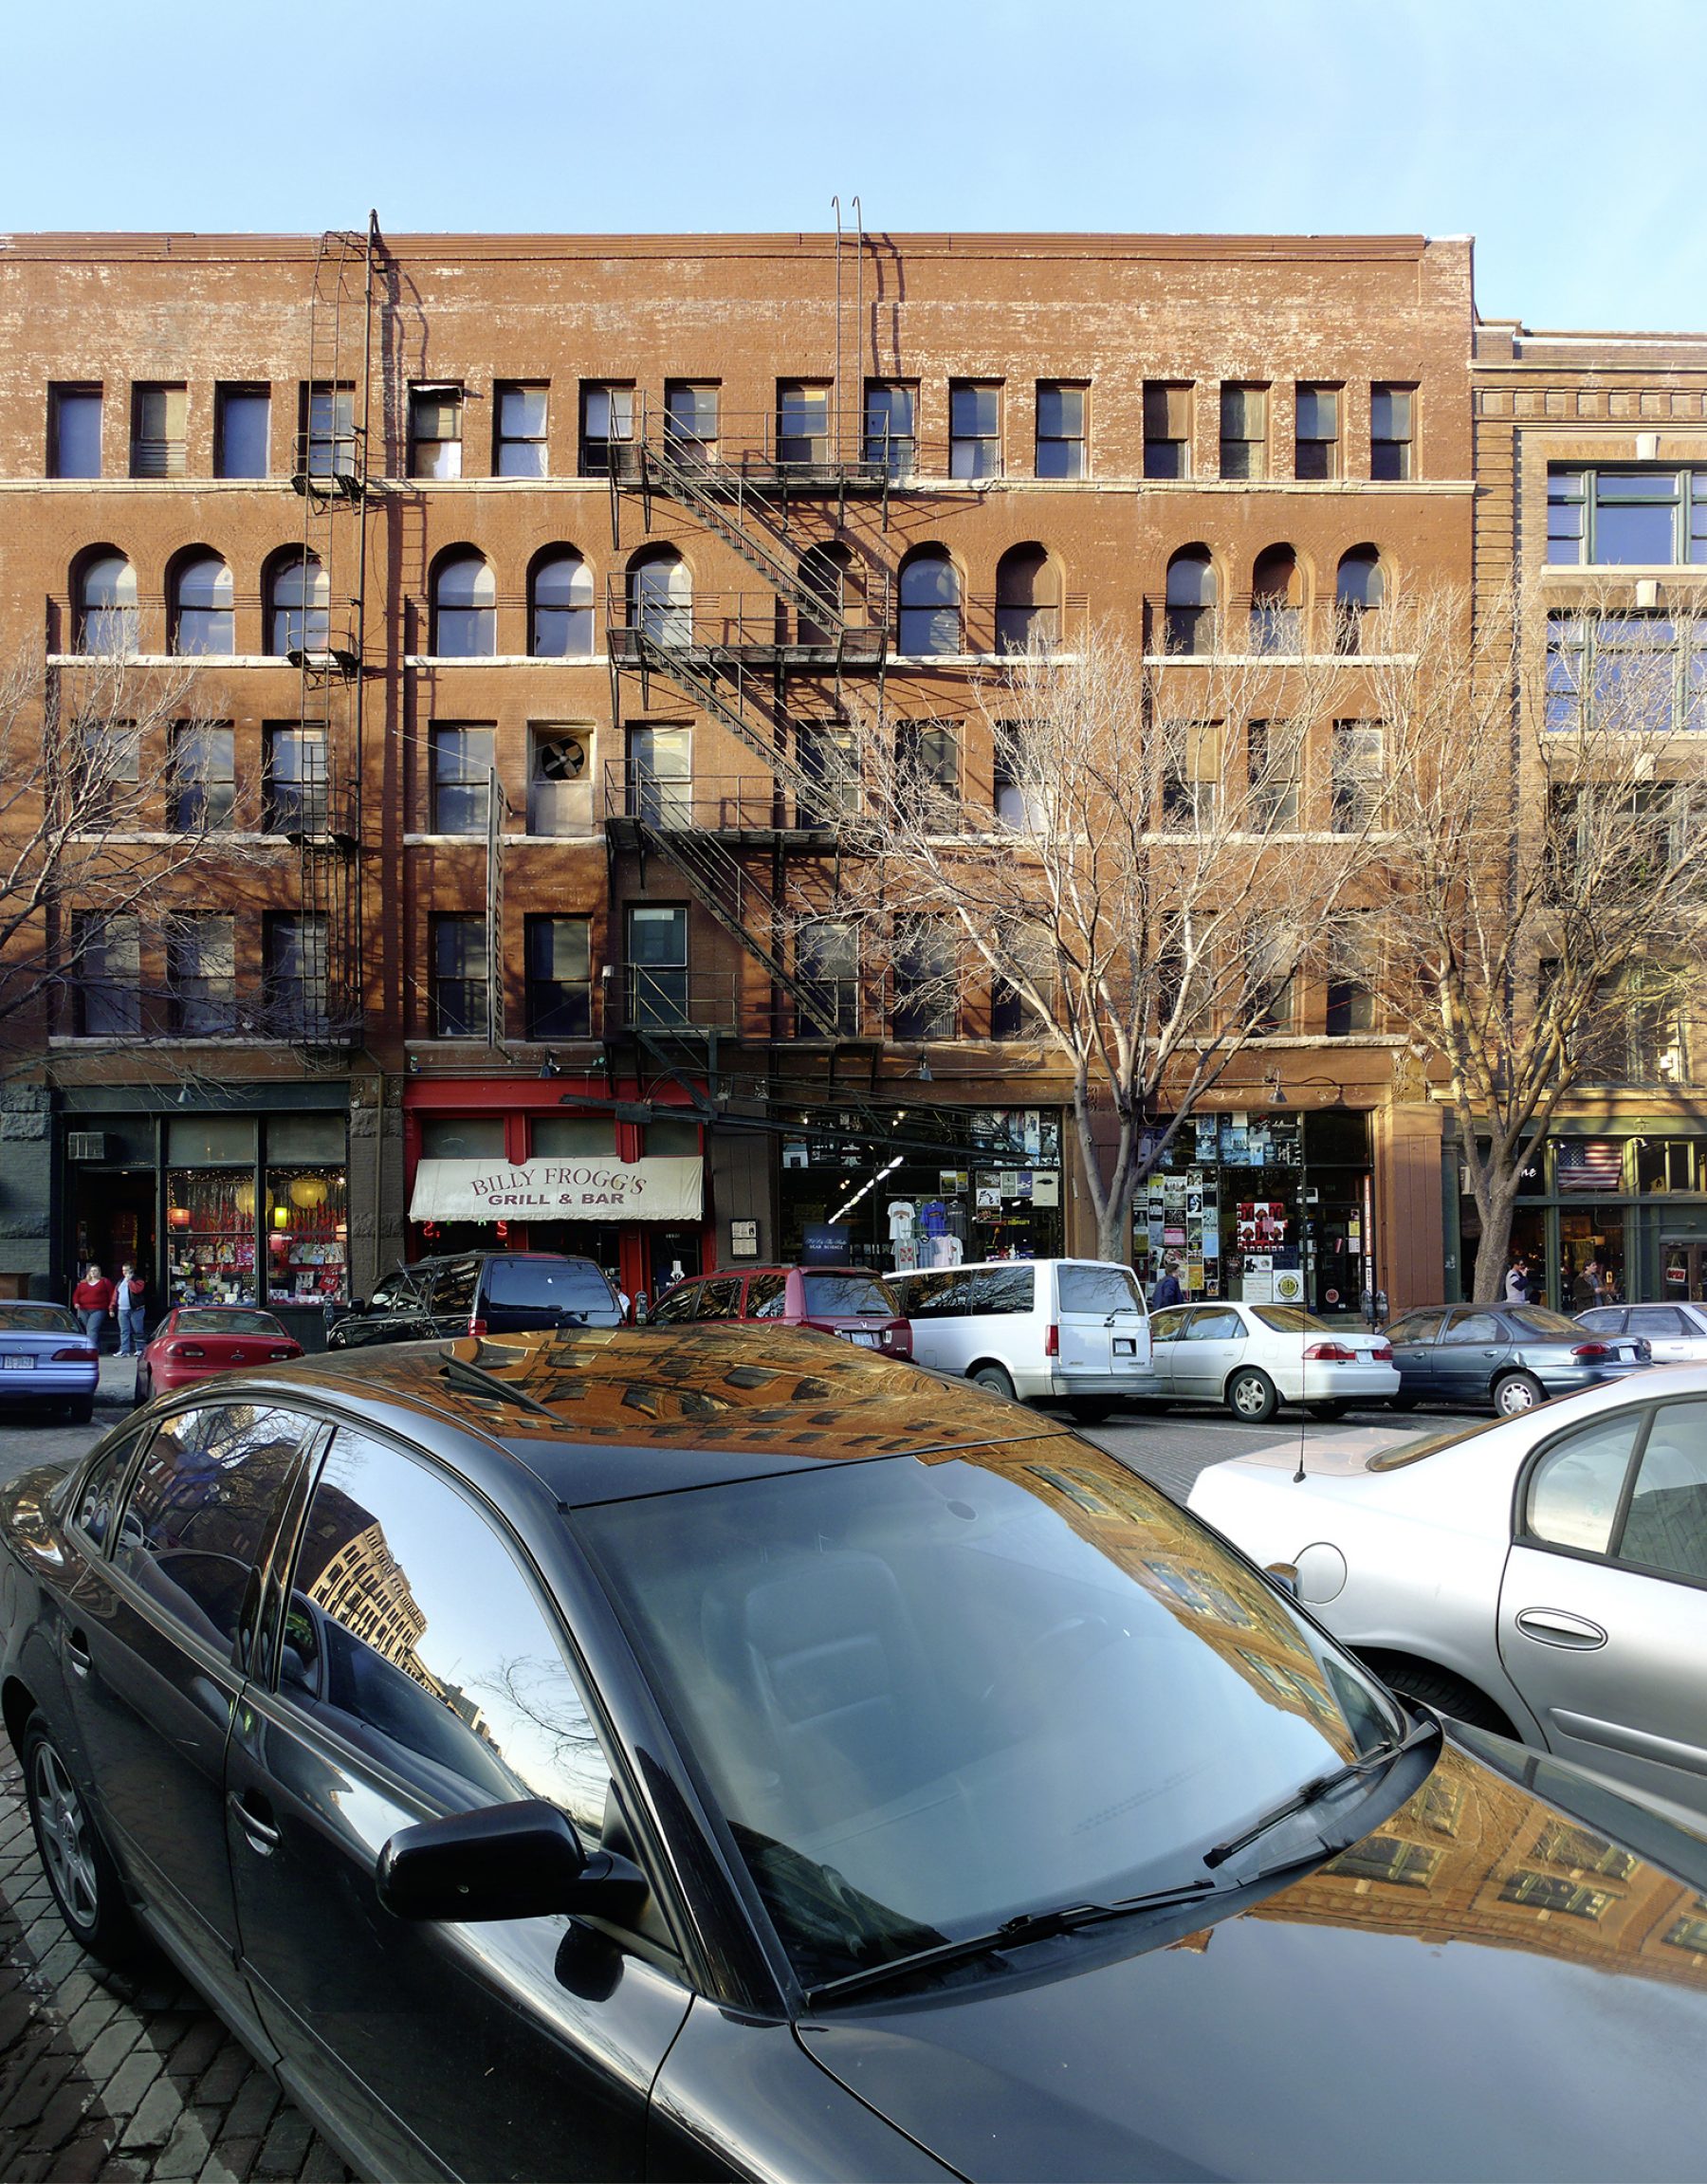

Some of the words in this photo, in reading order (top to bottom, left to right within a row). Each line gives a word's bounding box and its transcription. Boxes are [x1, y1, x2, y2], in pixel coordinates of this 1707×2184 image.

[469, 1168, 536, 1197] BILLY
[544, 1167, 647, 1196] FROGG'S
[488, 1194, 550, 1205] GRILL
[559, 1194, 573, 1204] &
[581, 1193, 624, 1204] BAR
